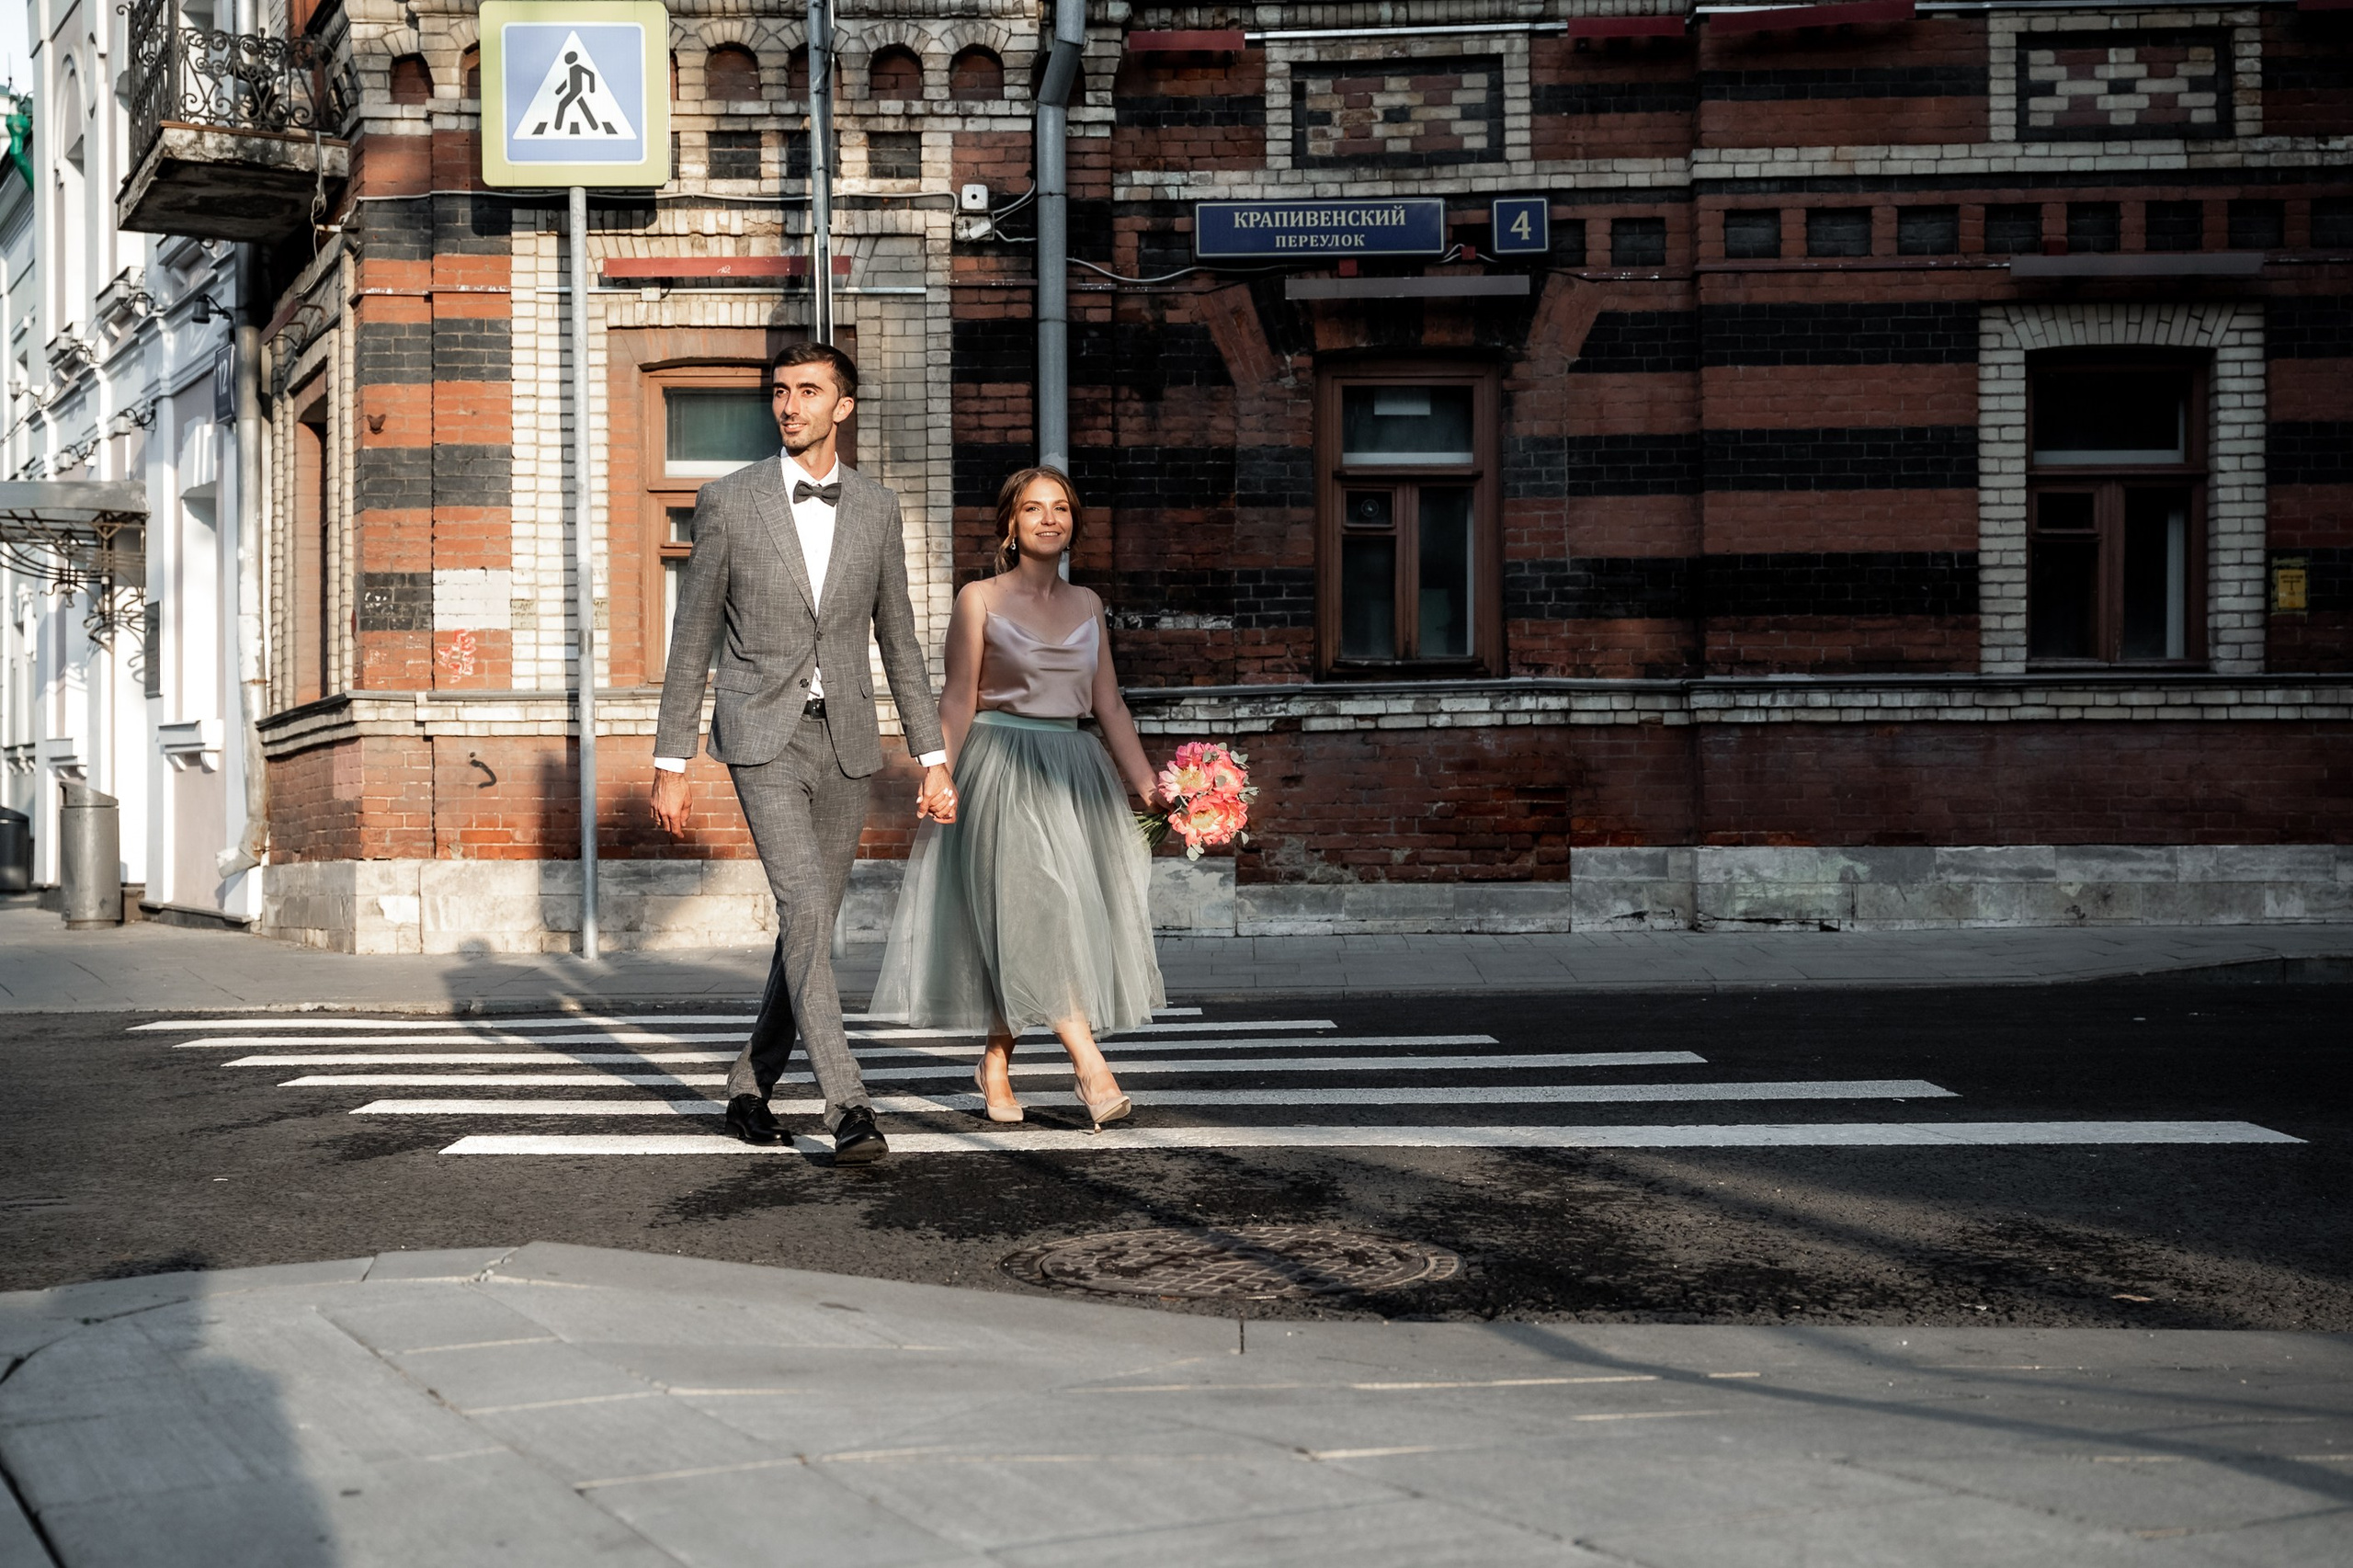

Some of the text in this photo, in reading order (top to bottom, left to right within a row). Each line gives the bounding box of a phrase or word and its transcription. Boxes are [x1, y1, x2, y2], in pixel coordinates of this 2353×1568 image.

[1233, 205, 1406, 229] КРАПИВЕНСКИЙ
[1510, 210, 1532, 241] 4
[1275, 233, 1366, 248] ПЕРЕУЛОК
[218, 358, 228, 396] 12
